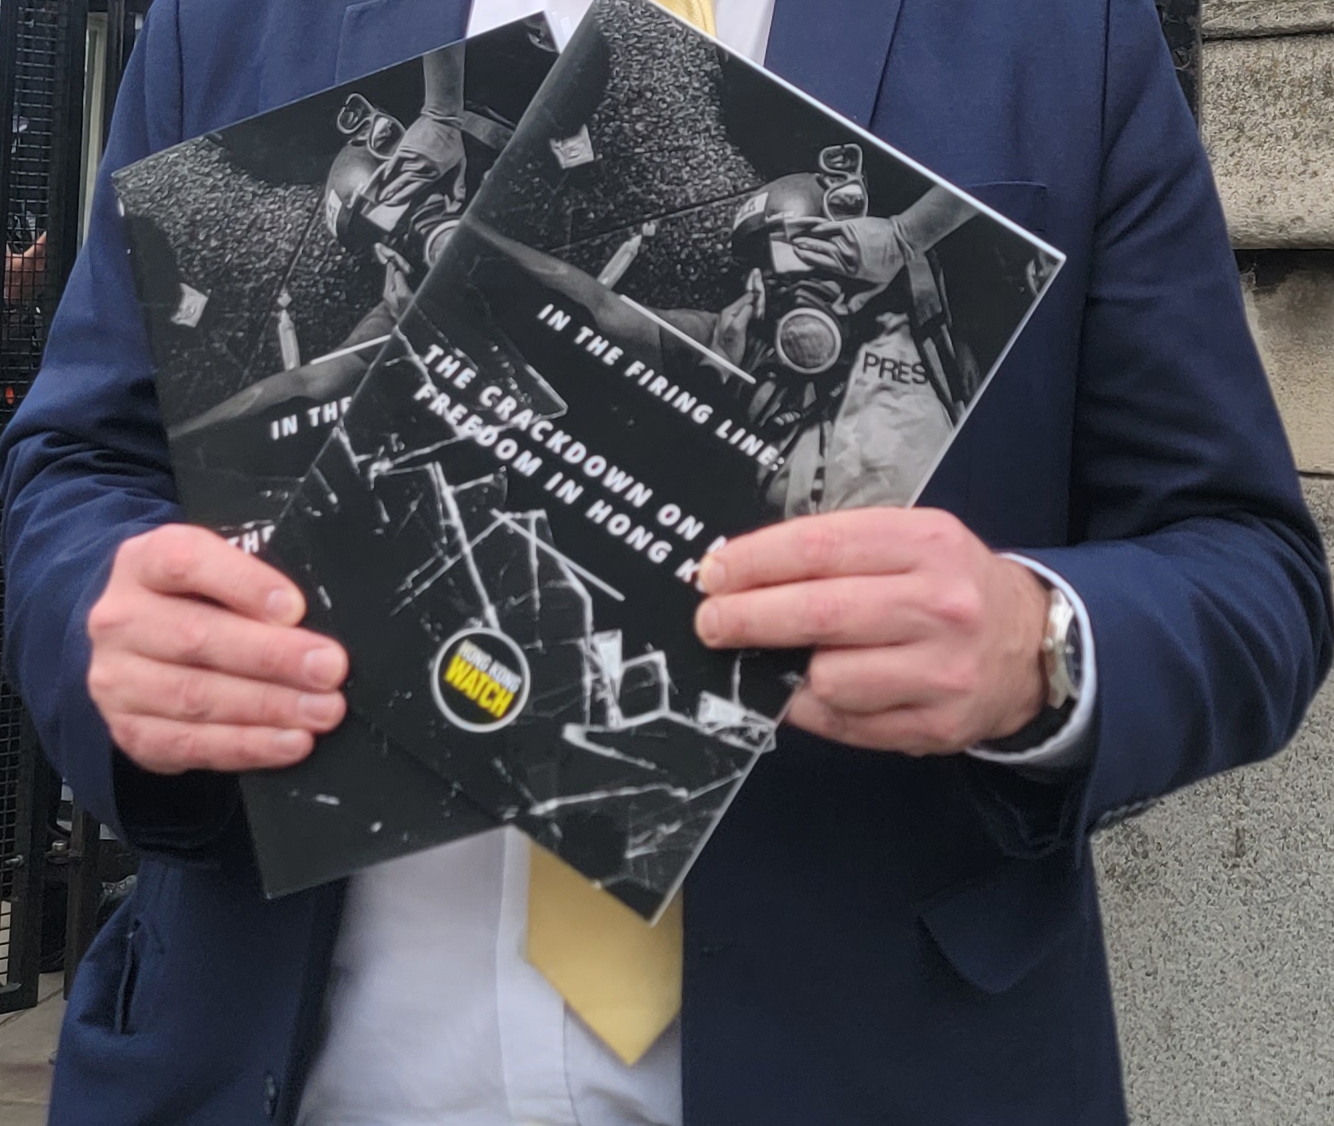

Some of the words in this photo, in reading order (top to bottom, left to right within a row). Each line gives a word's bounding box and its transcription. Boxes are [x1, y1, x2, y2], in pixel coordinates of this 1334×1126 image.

[270, 414, 298, 441] IN
[423, 344, 476, 390] THE
[479, 385, 654, 508] CRACKDOWN
[656, 503, 705, 542] ON
[537, 303, 571, 332] IN
[573, 325, 624, 366] THE
[623, 360, 714, 424] FIRING
[715, 419, 785, 472] LINE:
[413, 383, 543, 477] FREEDOM
[544, 472, 584, 505] IN
[585, 499, 673, 564] HONG
[444, 654, 514, 718] WATCH
